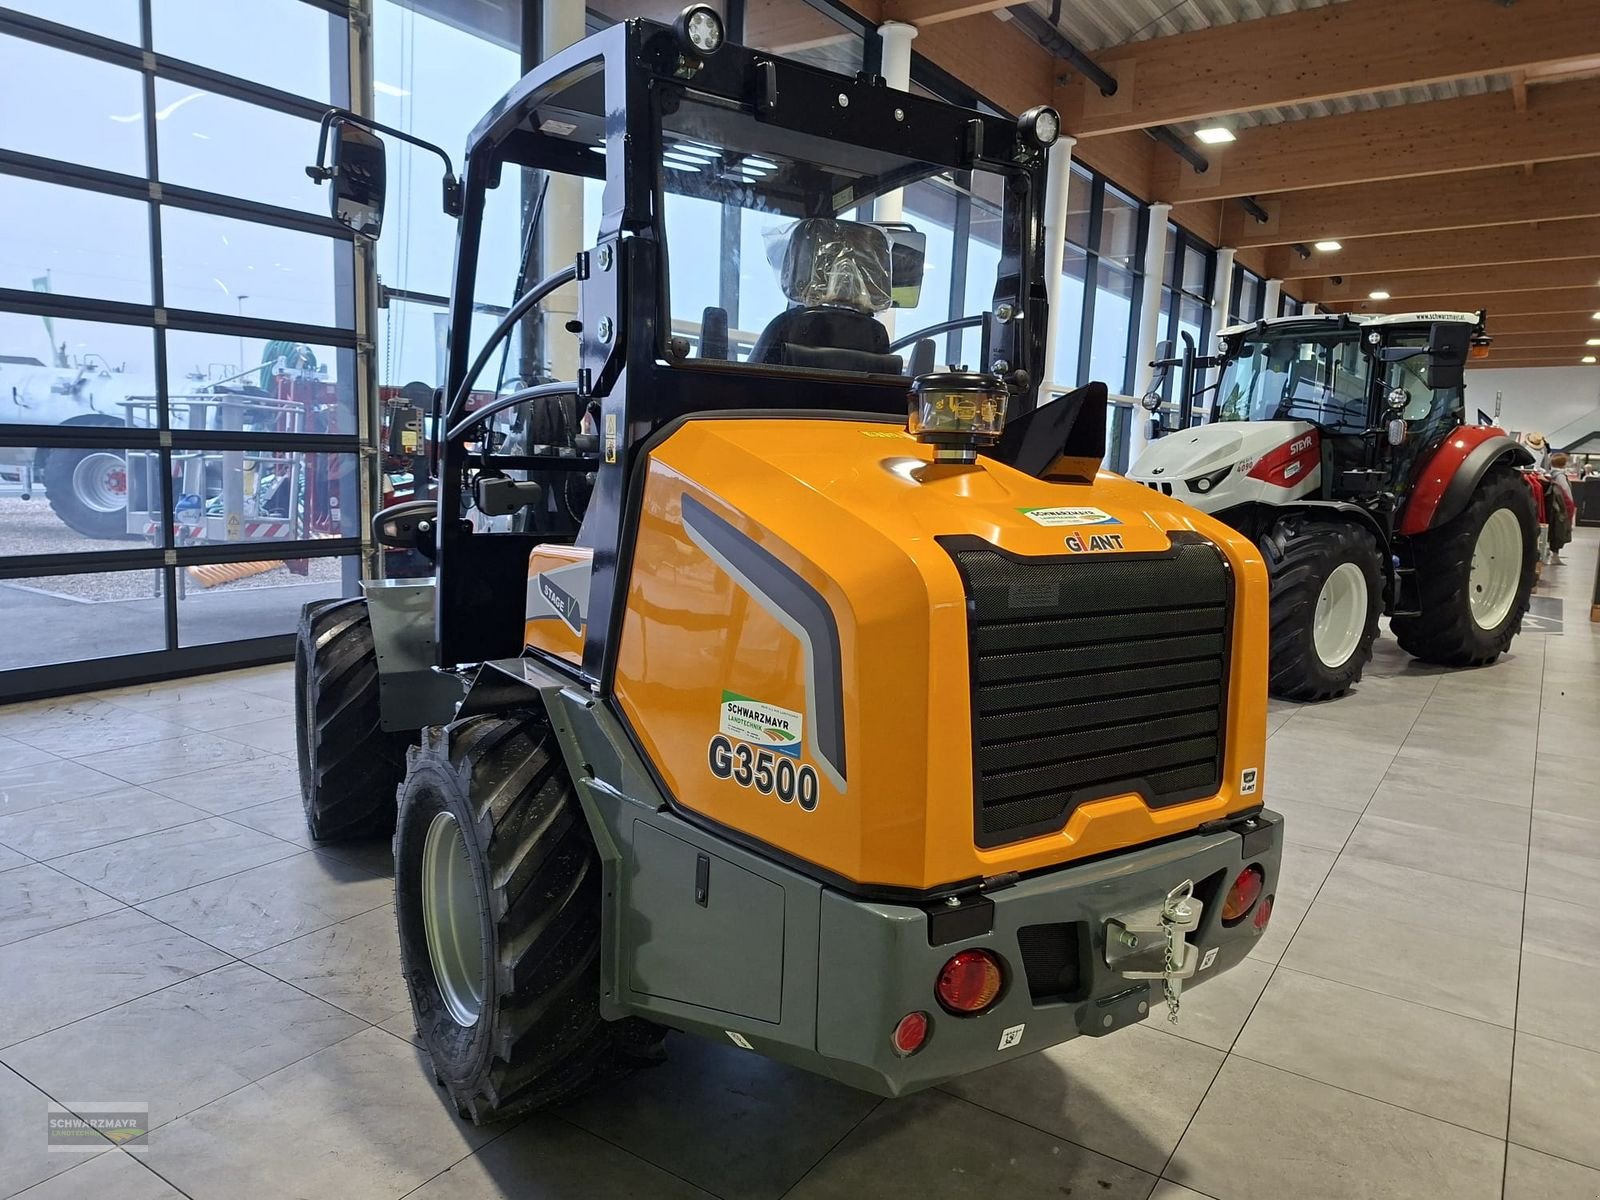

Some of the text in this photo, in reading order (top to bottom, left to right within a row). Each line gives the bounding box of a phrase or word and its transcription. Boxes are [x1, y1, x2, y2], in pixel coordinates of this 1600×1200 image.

[1290, 436, 1312, 456] STEYR
[544, 585, 577, 619] STAGE V
[727, 703, 789, 730] SCHWARZMAYR
[728, 715, 763, 731] LANDTECHNIK
[708, 733, 819, 812] G3500
